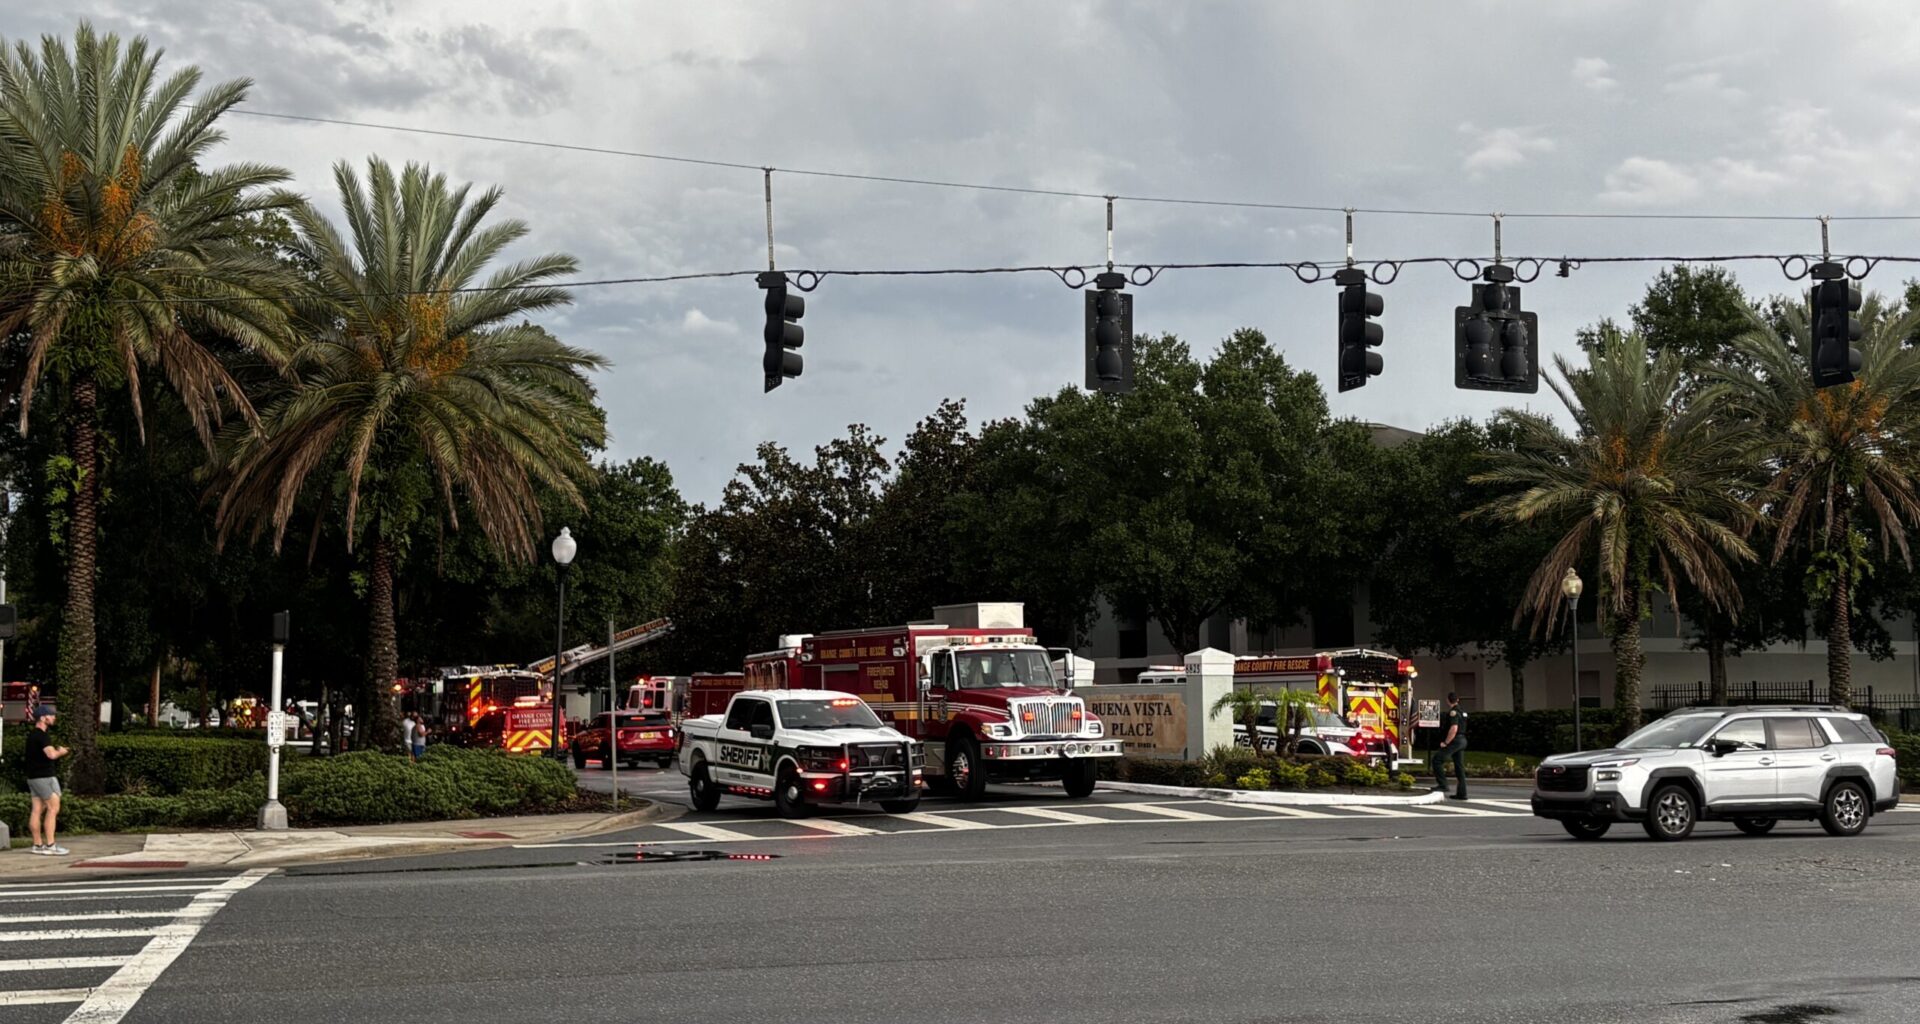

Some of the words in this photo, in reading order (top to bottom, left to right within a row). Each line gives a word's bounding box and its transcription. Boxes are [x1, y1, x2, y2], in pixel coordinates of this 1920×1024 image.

[1251, 661, 1273, 672] COUNTY
[1273, 660, 1287, 671] FIRE
[1287, 660, 1310, 670] RESCUE
[1092, 702, 1131, 716] BUENA
[1133, 702, 1173, 716] VISTA
[1111, 722, 1154, 736] PLACE
[720, 744, 760, 767] SHERIFF
